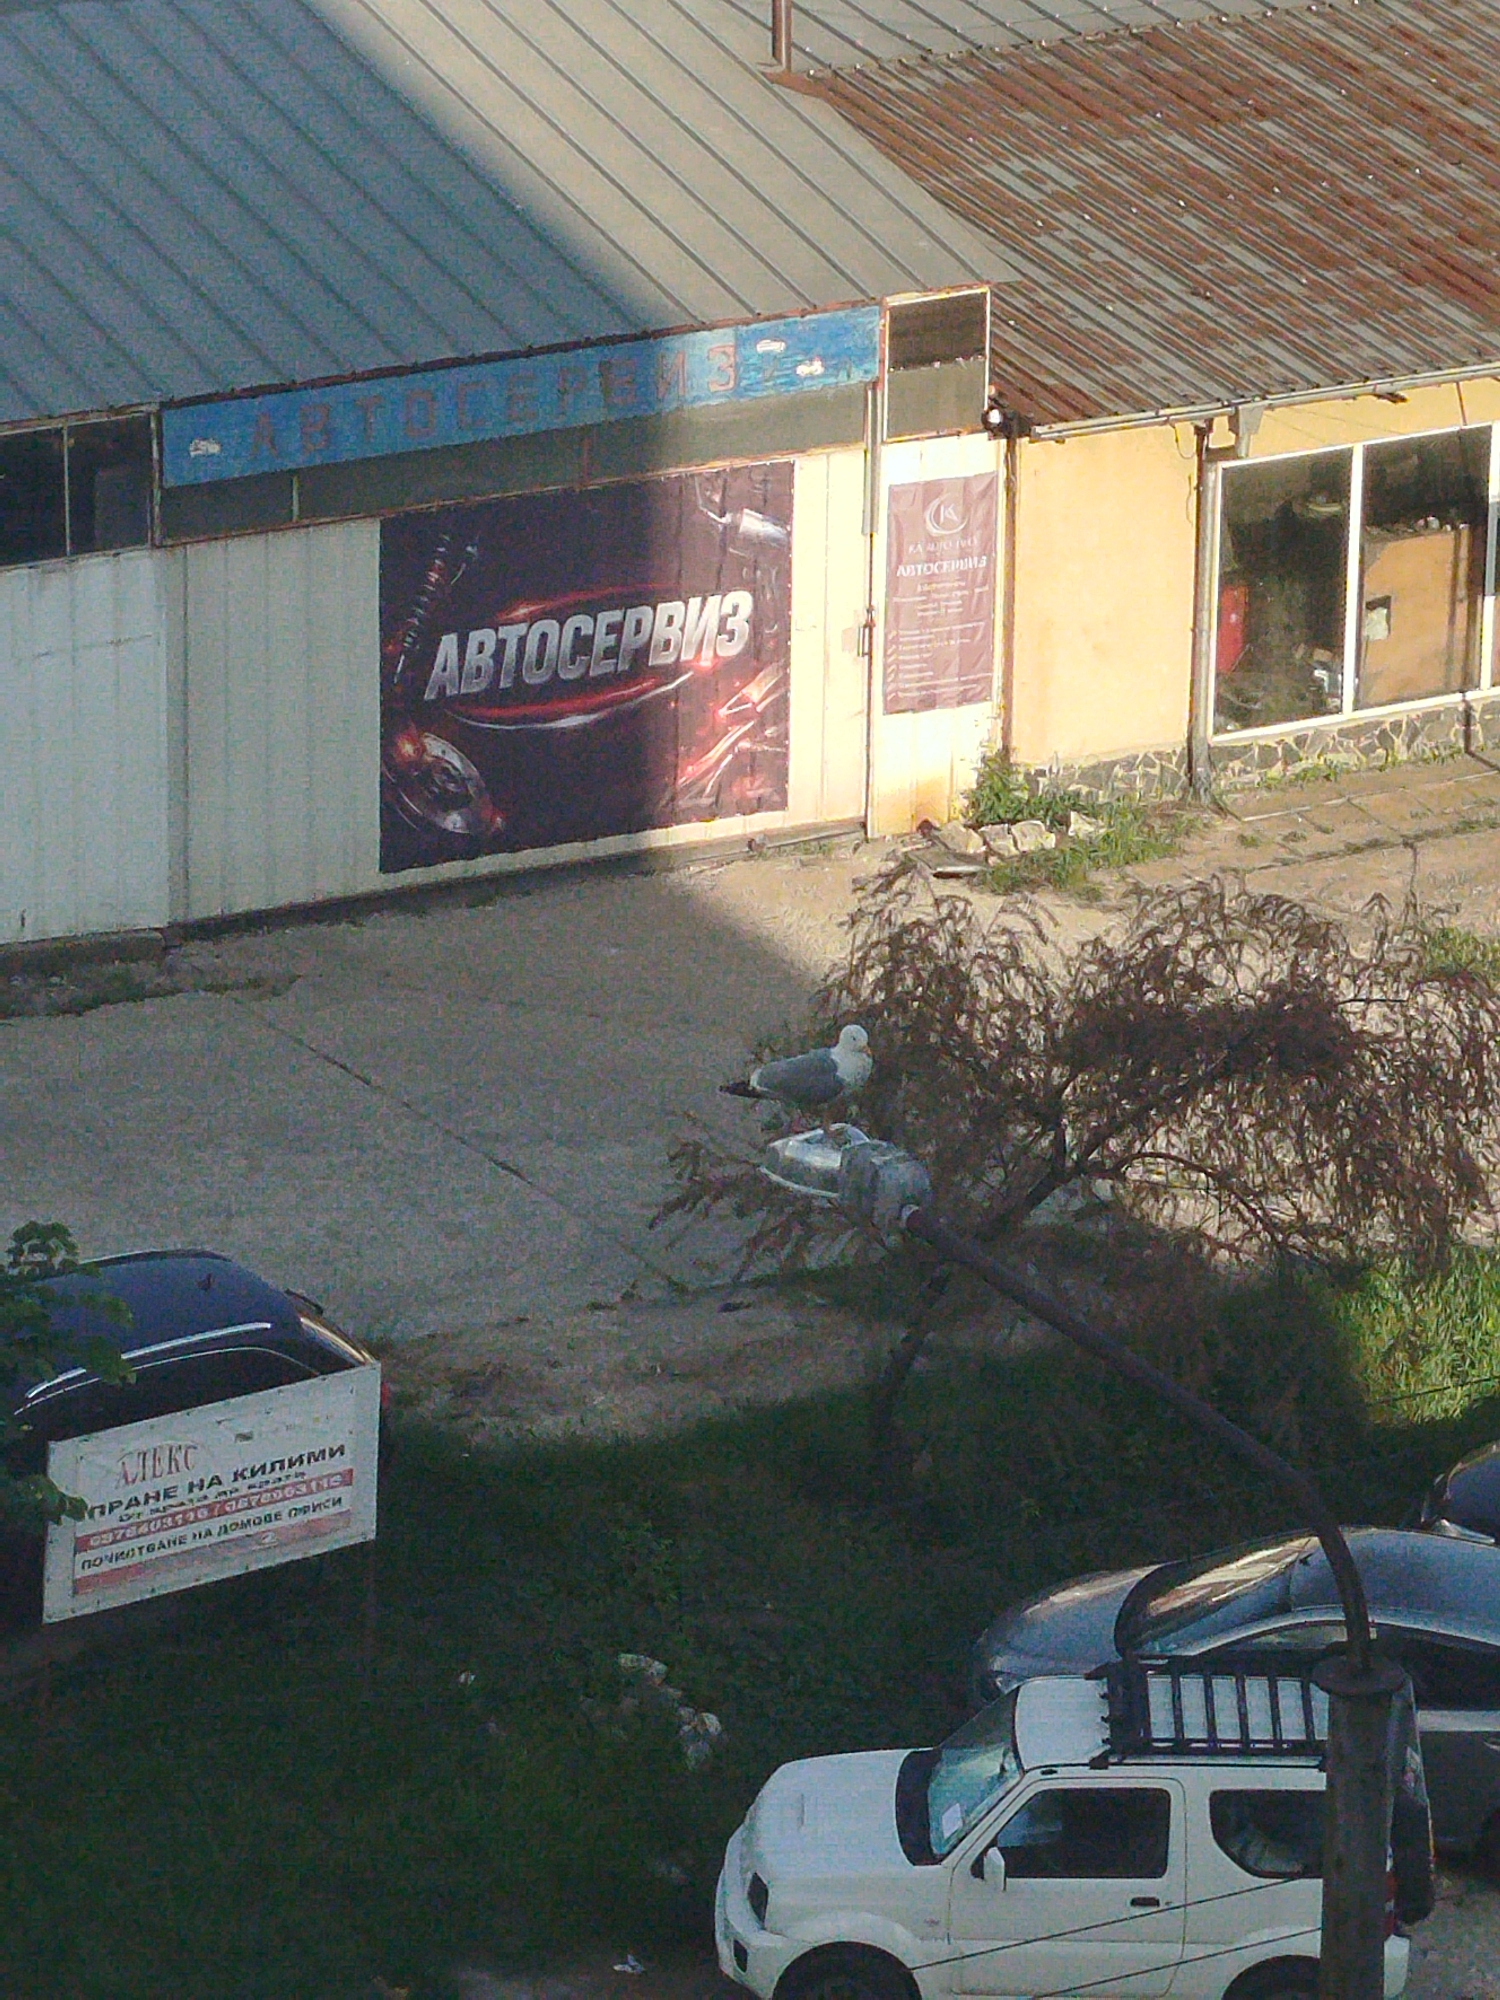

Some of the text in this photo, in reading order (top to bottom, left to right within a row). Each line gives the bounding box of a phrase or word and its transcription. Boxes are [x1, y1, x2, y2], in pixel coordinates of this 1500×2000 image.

[424, 590, 753, 700] АВТОСЕРВИЗ
[87, 1442, 344, 1519] ПРАНЕ НА КИЛИМИ
